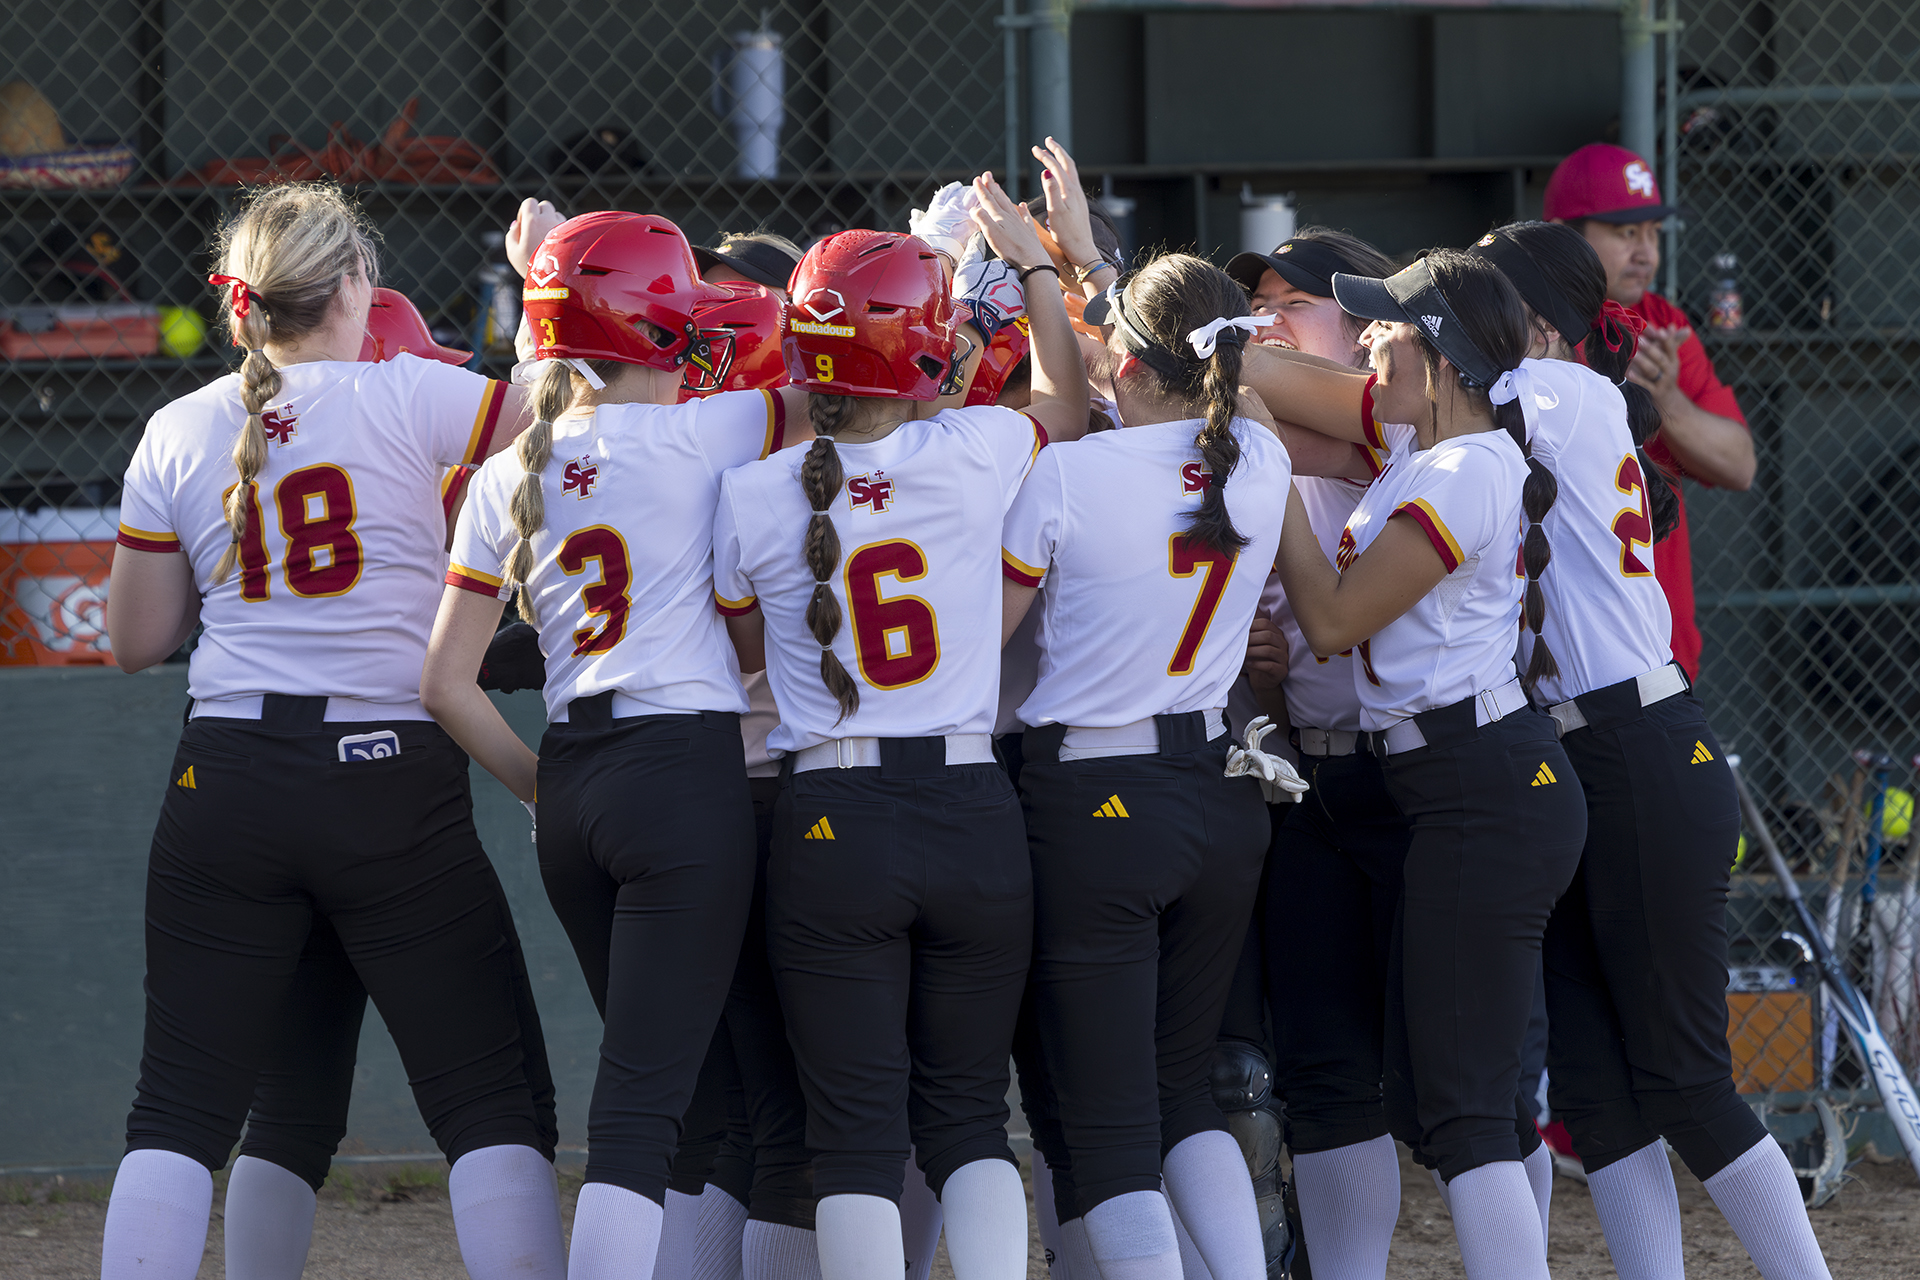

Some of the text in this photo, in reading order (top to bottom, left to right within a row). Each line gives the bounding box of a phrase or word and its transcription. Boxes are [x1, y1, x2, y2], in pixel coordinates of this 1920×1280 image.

[1624, 161, 1654, 199] SF
[540, 318, 556, 347] 3
[790, 318, 855, 338] Troubadours
[1421, 315, 1440, 337] adidas
[816, 354, 834, 382] 9
[261, 407, 300, 447] SF
[561, 457, 599, 500] SF
[846, 473, 894, 514] SF
[221, 462, 364, 603] 18
[556, 523, 633, 657] 3
[1167, 531, 1240, 676] 7
[843, 538, 941, 691] 6
